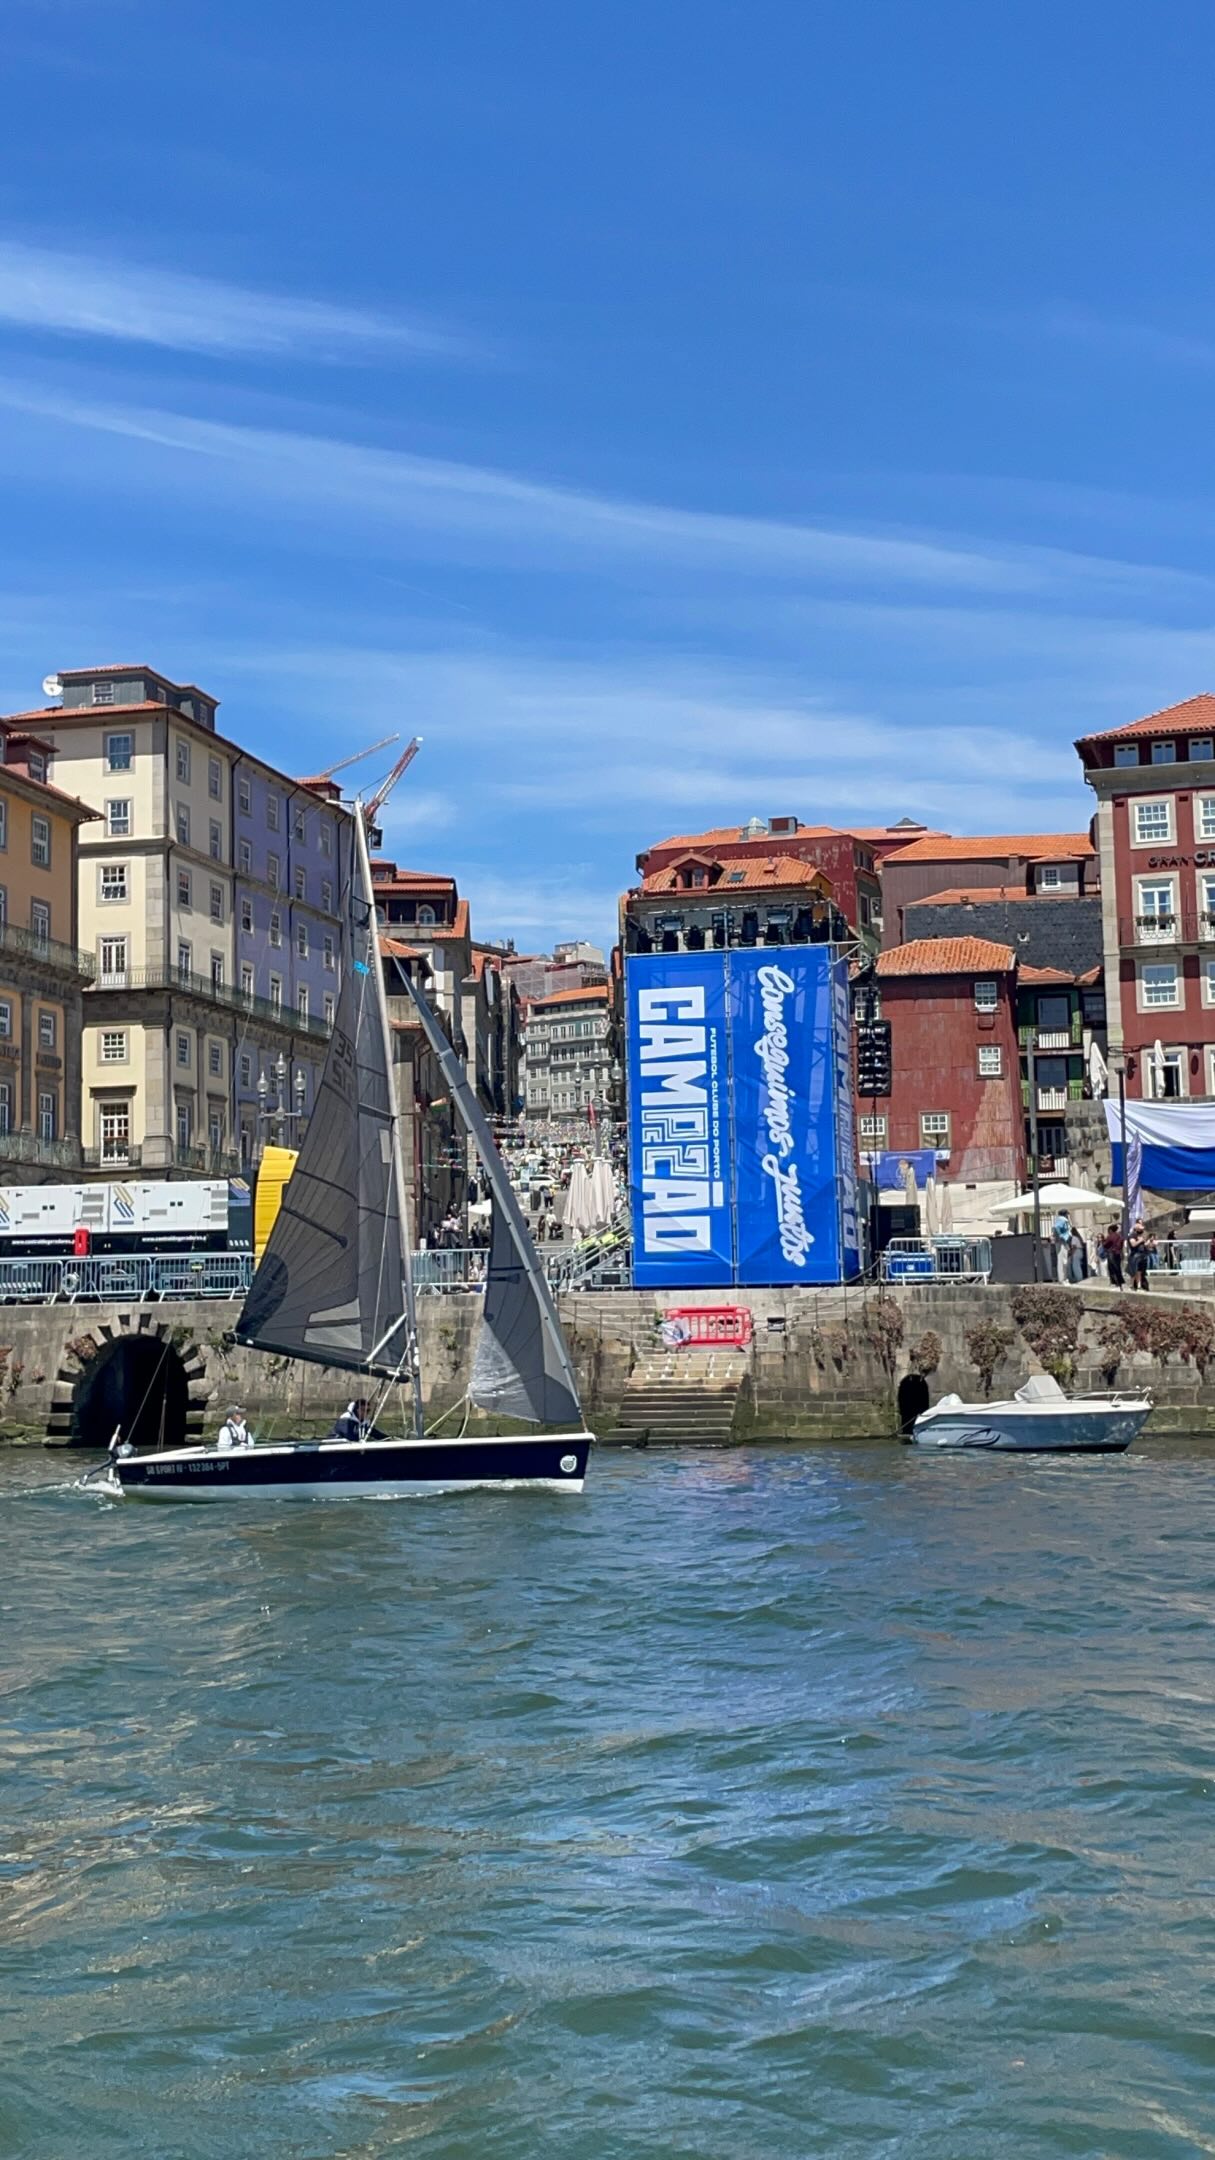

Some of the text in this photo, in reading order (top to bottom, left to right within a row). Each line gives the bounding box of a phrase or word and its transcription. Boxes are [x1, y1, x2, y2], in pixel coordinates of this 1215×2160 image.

[1148, 855, 1189, 868] GRAN
[710, 1027, 718, 1079] FUTEBOL
[754, 965, 795, 1156] Conseguimos
[711, 1080, 719, 1118] CLUBE
[712, 1120, 720, 1137] DO
